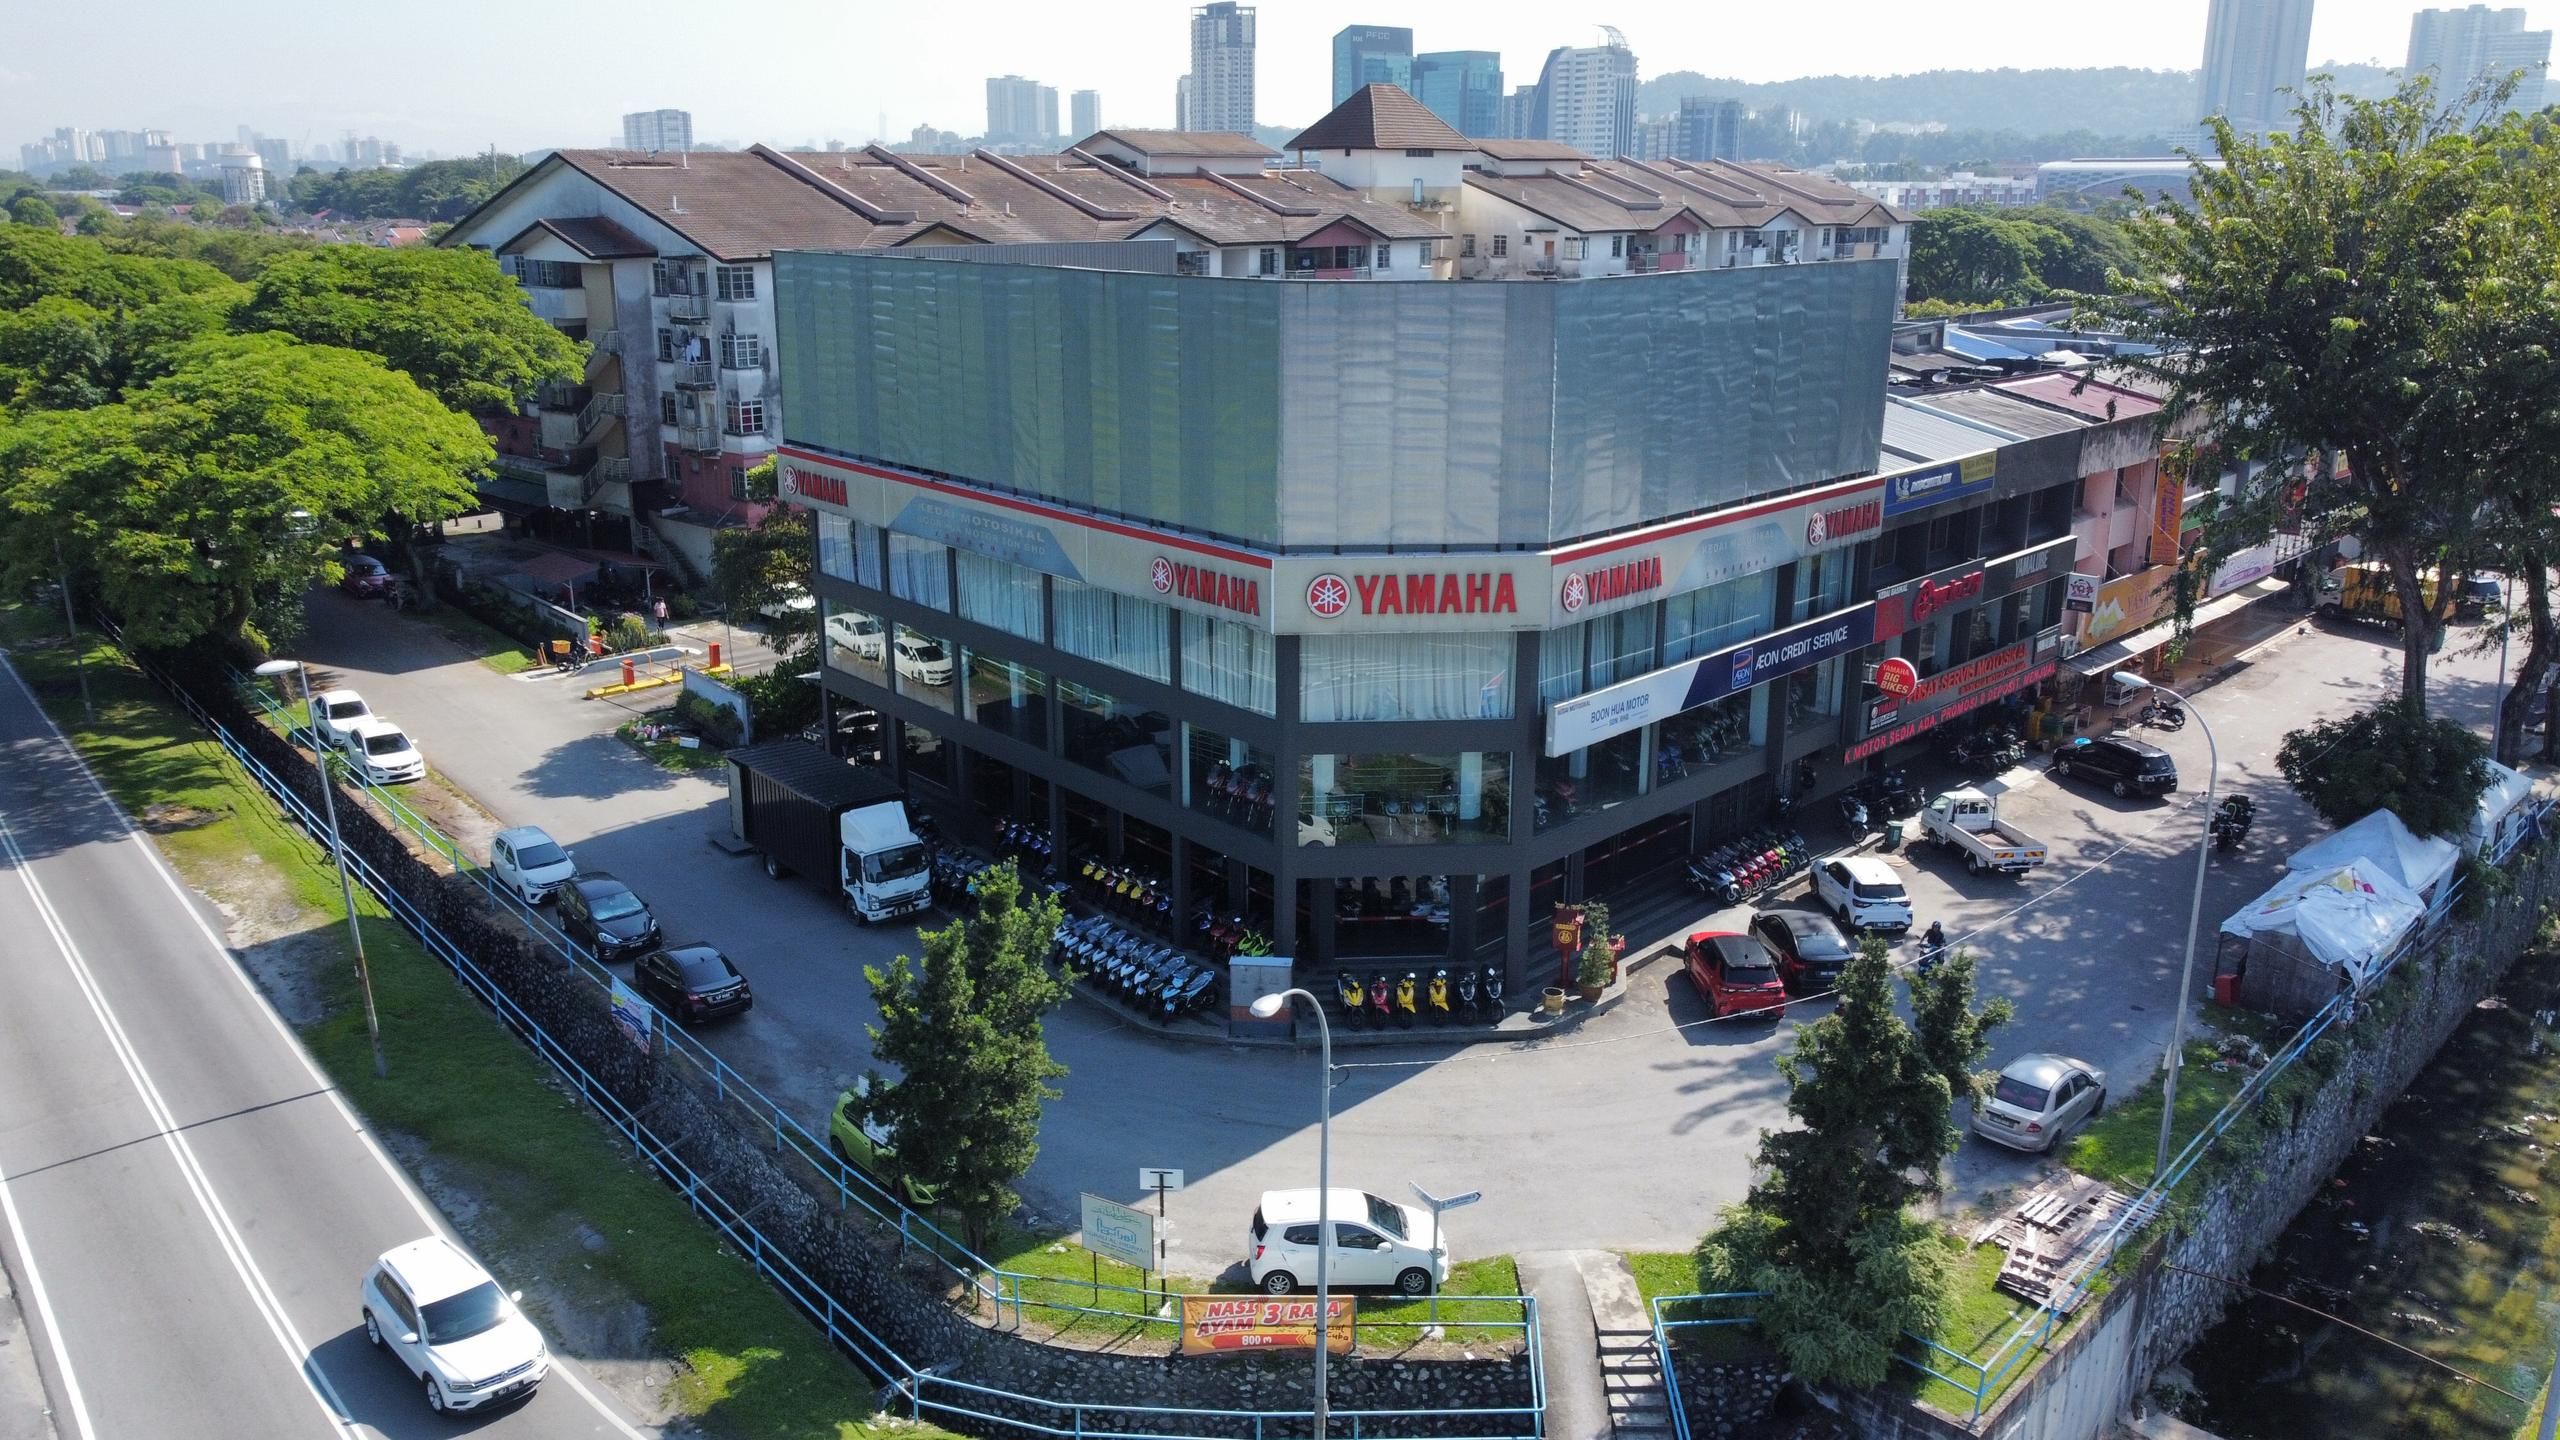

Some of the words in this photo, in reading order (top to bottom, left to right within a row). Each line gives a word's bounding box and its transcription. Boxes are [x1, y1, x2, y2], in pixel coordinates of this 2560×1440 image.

[797, 469, 849, 508] YAMAHA
[1825, 499, 1881, 541] YAMAHA
[1173, 562, 1260, 617] YAMAHA
[1354, 572, 1518, 615] YAMAHA
[1585, 555, 1663, 606] YAMAHA
[1780, 638, 1812, 662] CREDIT
[1812, 625, 1849, 650] SERVICE
[1883, 663, 1910, 676] YAMAHA
[1883, 672, 1901, 683] BIG
[1880, 680, 1909, 694] BIKES
[1591, 707, 1610, 723] BOON
[1610, 702, 1625, 716] HUA
[1626, 694, 1649, 710] MOTOR
[1853, 738, 1886, 761] MOTOR
[1889, 723, 1916, 747] SEDIA
[1940, 697, 1977, 723] PROMOSI
[1195, 1316, 1256, 1337] AYAM
[1206, 1301, 1258, 1319] NASI
[1262, 1302, 1281, 1325] 3
[1287, 1300, 1342, 1321] RAA
[1241, 1334, 1261, 1345] 800
